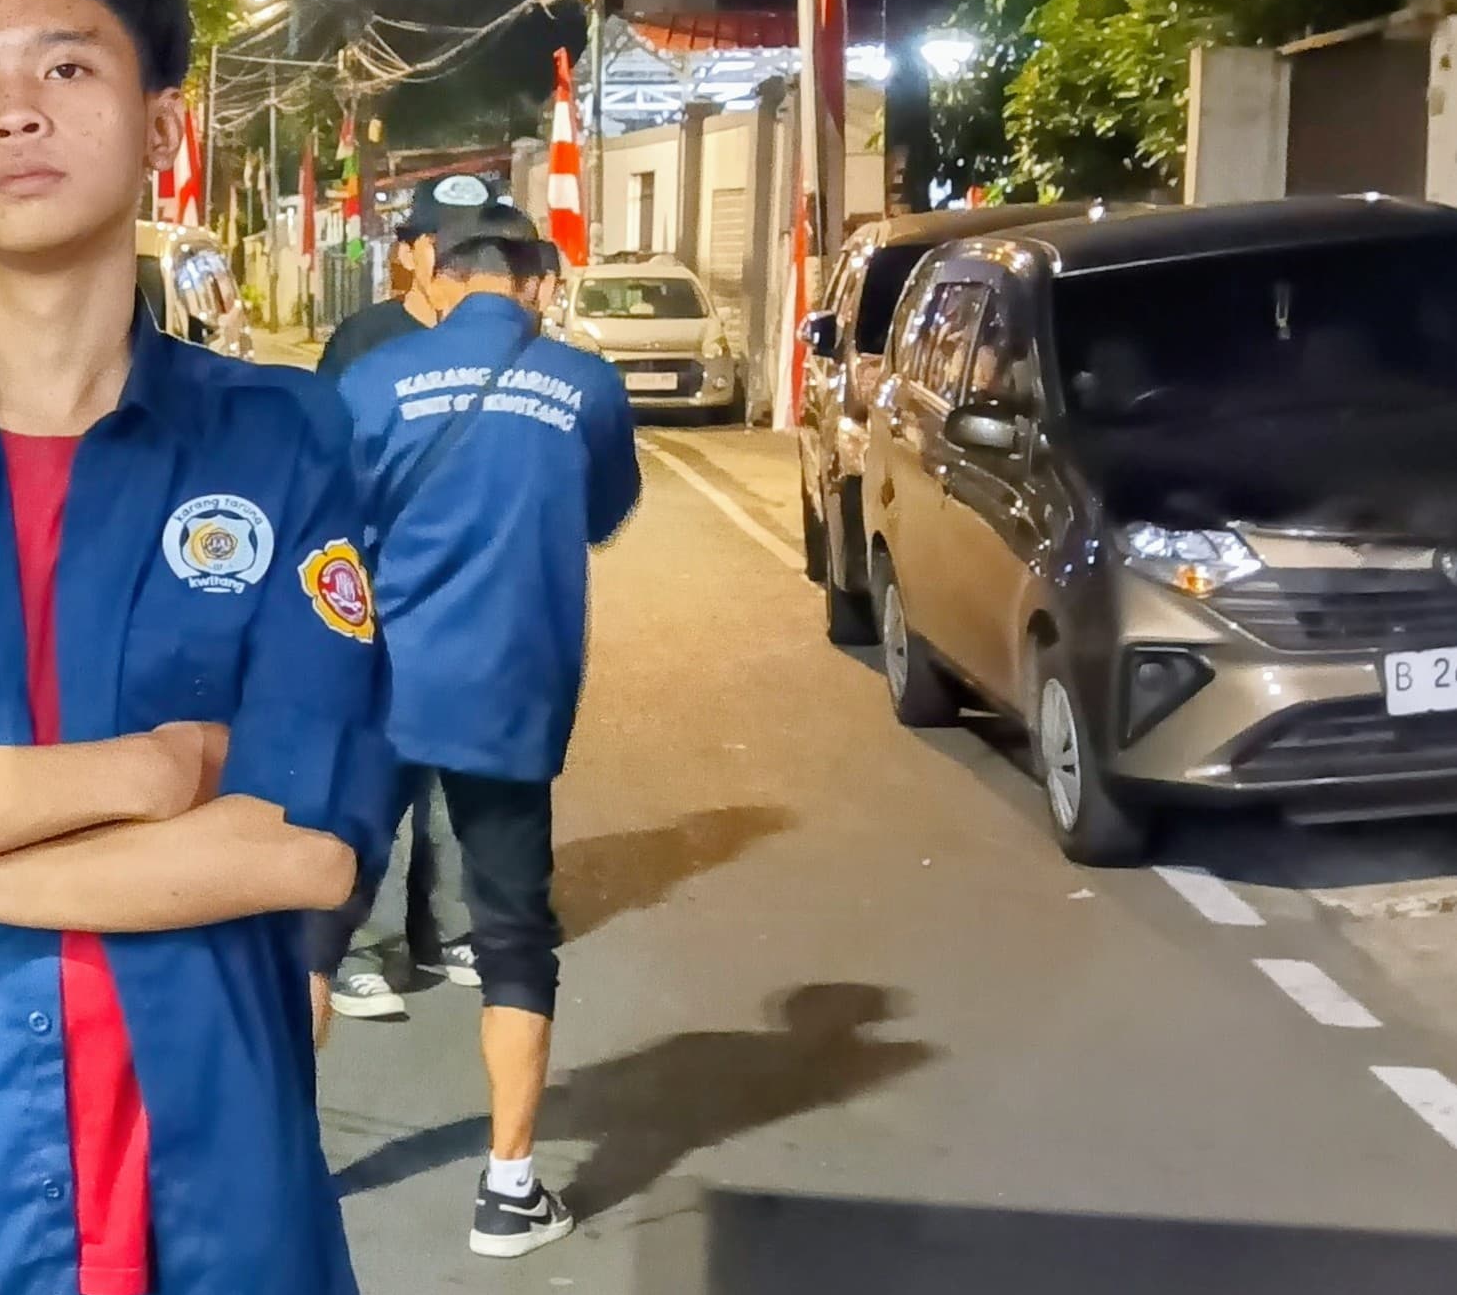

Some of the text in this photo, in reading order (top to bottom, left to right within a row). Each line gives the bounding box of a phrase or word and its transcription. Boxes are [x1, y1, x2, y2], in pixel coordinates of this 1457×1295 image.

[173, 498, 220, 523] karang
[188, 575, 246, 594] kwitang
[1396, 657, 1457, 691] B 2
